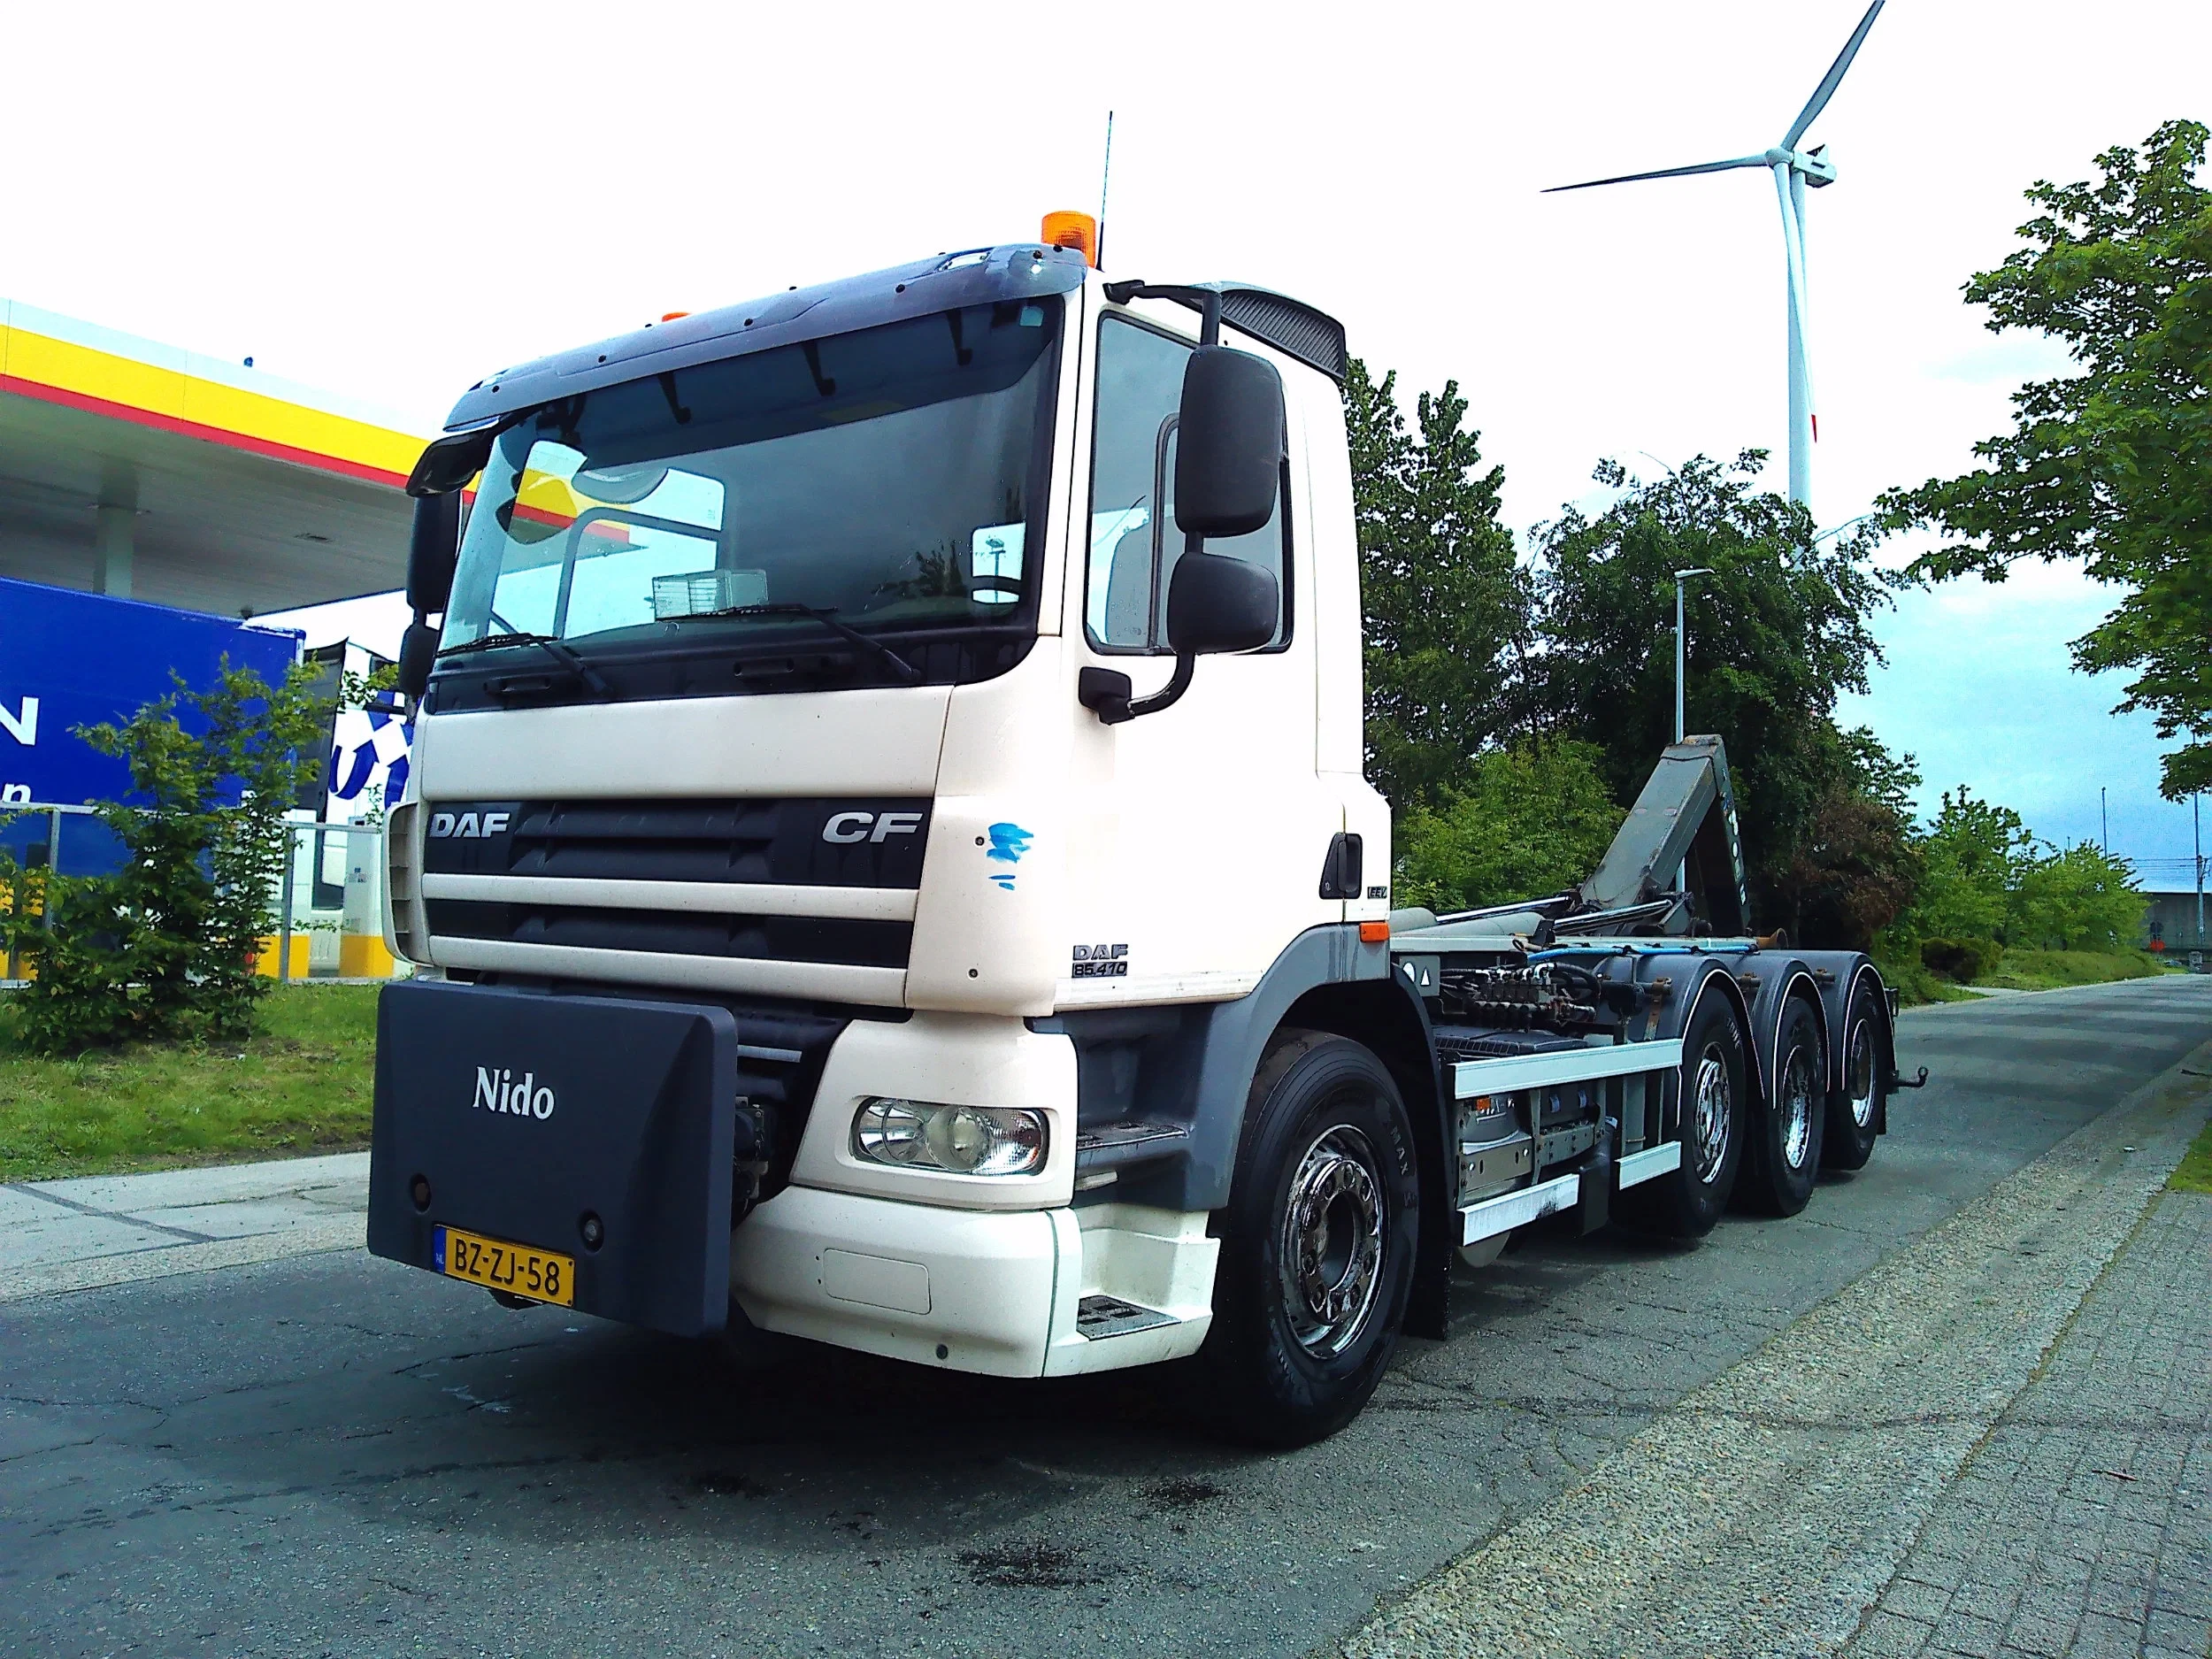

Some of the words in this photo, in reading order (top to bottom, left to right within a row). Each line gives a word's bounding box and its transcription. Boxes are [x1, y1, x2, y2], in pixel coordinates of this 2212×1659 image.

[429, 812, 511, 838] DAF
[822, 811, 923, 843] CF
[1368, 887, 1387, 899] EEV
[1072, 944, 1128, 961] DAF
[472, 1066, 555, 1119] Nido
[455, 1238, 560, 1296] BZ-ZJ-58
